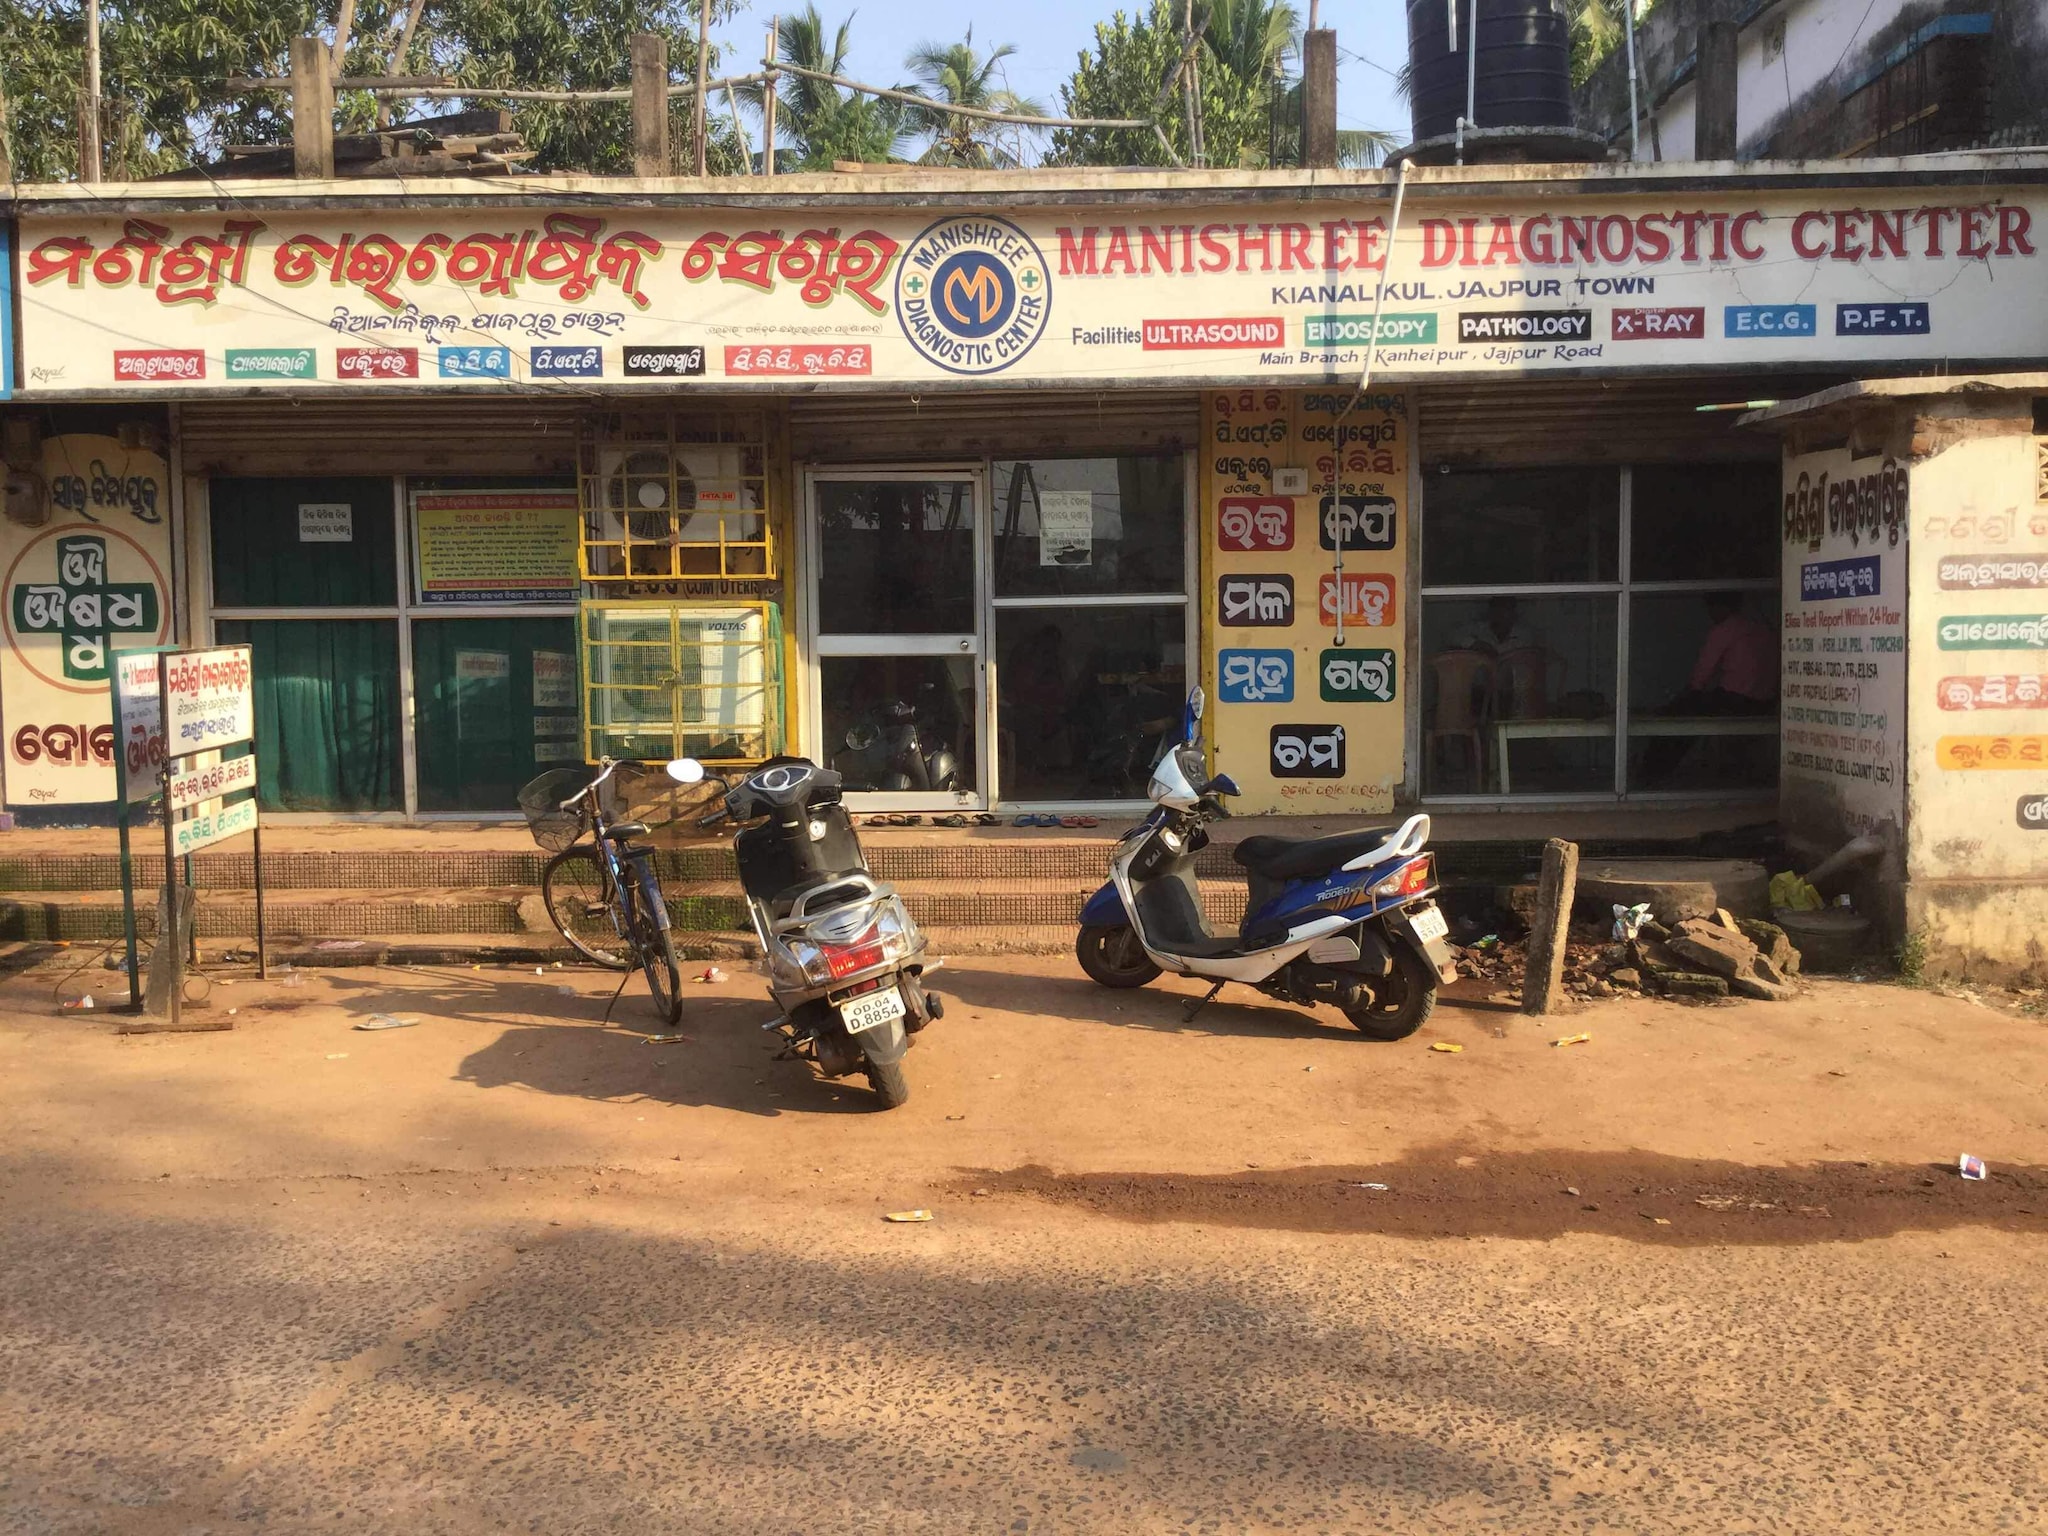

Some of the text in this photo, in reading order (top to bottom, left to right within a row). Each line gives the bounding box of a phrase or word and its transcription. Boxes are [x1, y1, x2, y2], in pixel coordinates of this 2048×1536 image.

[913, 223, 1029, 270] MANISHREE
[1056, 205, 2036, 276] MANISHREE DIAGNOSTIC CENTER
[1446, 279, 1562, 301] JAJPUR
[1573, 277, 1655, 296] TOWN
[1460, 315, 1588, 338] PATHOLOGY
[1616, 313, 1697, 334] X-RAY
[1736, 311, 1809, 331] E.C.G.
[1843, 308, 1924, 329] P.F.T.
[904, 295, 1042, 365] DIAGNOSTIC CENTER
[1072, 326, 1141, 346] Facilities
[1146, 323, 1279, 345] ULTRASOUND
[1306, 319, 1427, 341] ENDOSCOPY
[1259, 352, 1294, 366] Main
[1482, 345, 1548, 365] Jajpur
[1553, 344, 1604, 362] Road
[1221, 504, 1289, 550] ରକ୍ତ
[708, 622, 747, 631] VOLTAS
[1802, 611, 1817, 628] Test
[1818, 609, 1844, 634] Report
[1844, 607, 1868, 628] Within
[1869, 606, 1881, 626] 24
[1882, 606, 1901, 625] Hour
[1840, 710, 1857, 727] TEST
[1273, 725, 1344, 769] ଚର୍ମ
[850, 1003, 900, 1030] D.8854
[853, 996, 890, 1015] OD.04
